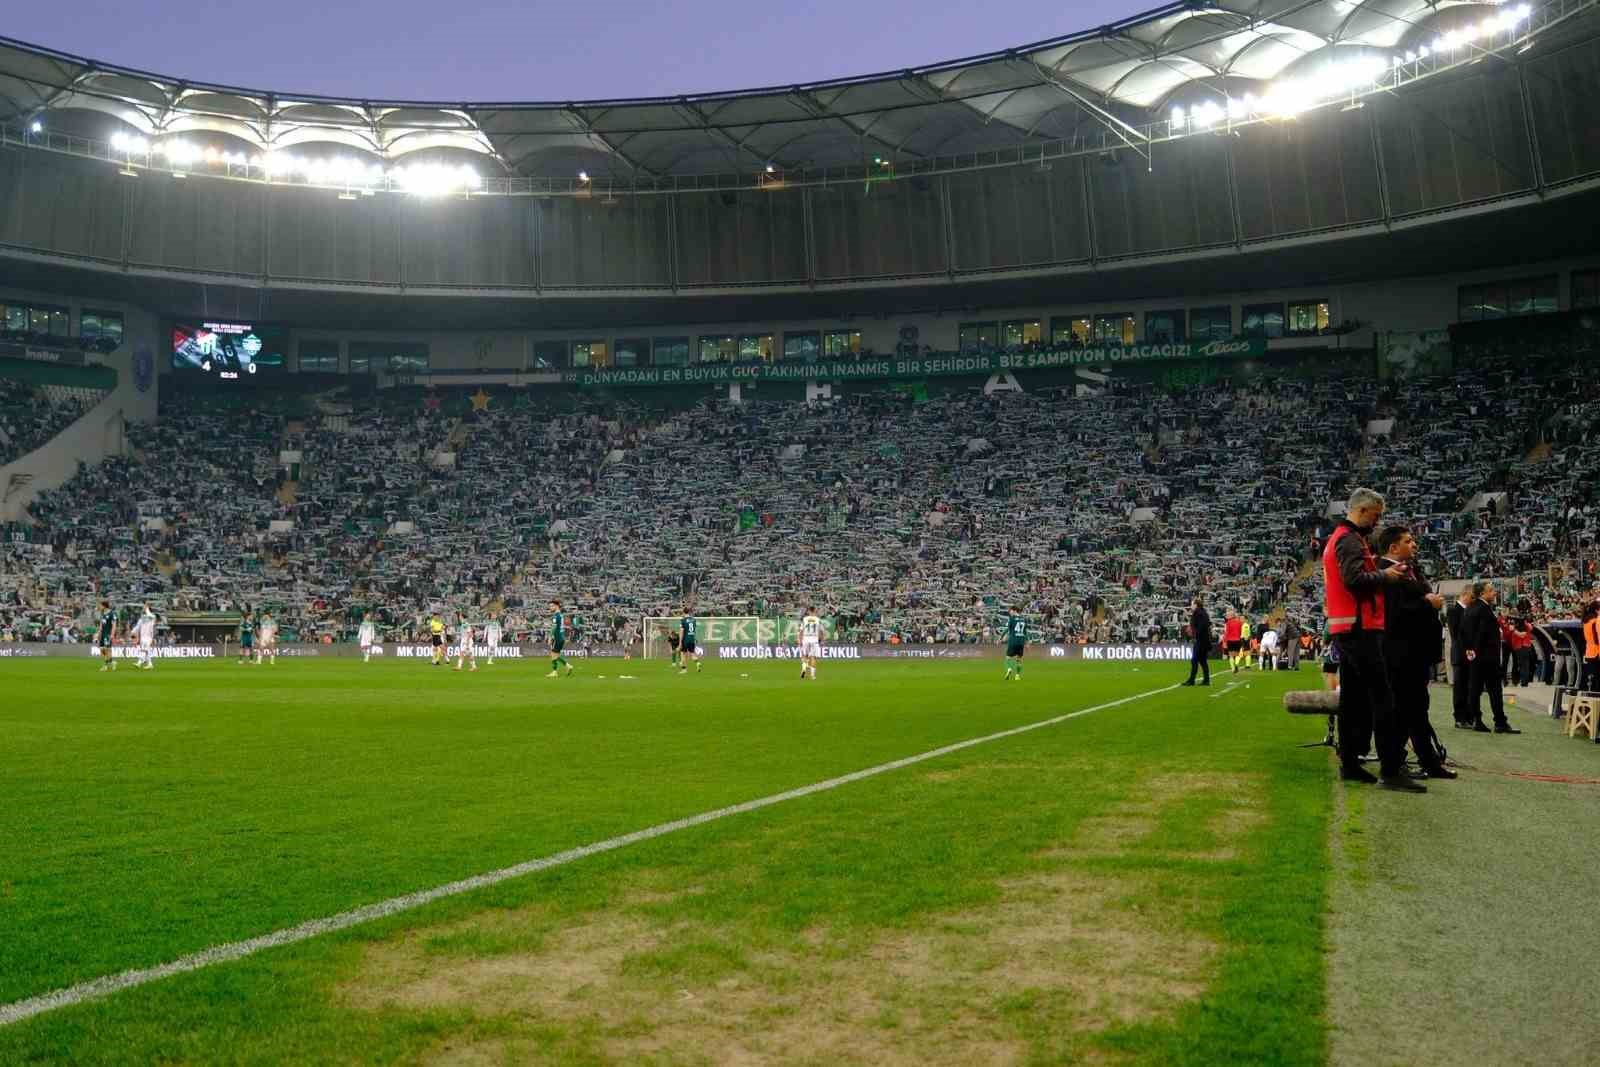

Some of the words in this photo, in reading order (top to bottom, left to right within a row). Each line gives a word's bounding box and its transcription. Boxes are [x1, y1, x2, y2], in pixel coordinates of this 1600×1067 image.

[202, 361, 211, 371] 4
[248, 363, 257, 374] 0
[663, 368, 680, 381] EN
[896, 358, 918, 374] BİR
[999, 353, 1024, 368] BİZ
[1014, 622, 1025, 633] 47
[396, 646, 413, 657] MK
[719, 646, 738, 658] MK
[1082, 646, 1104, 659] MK
[1107, 645, 1142, 659] DOĞA
